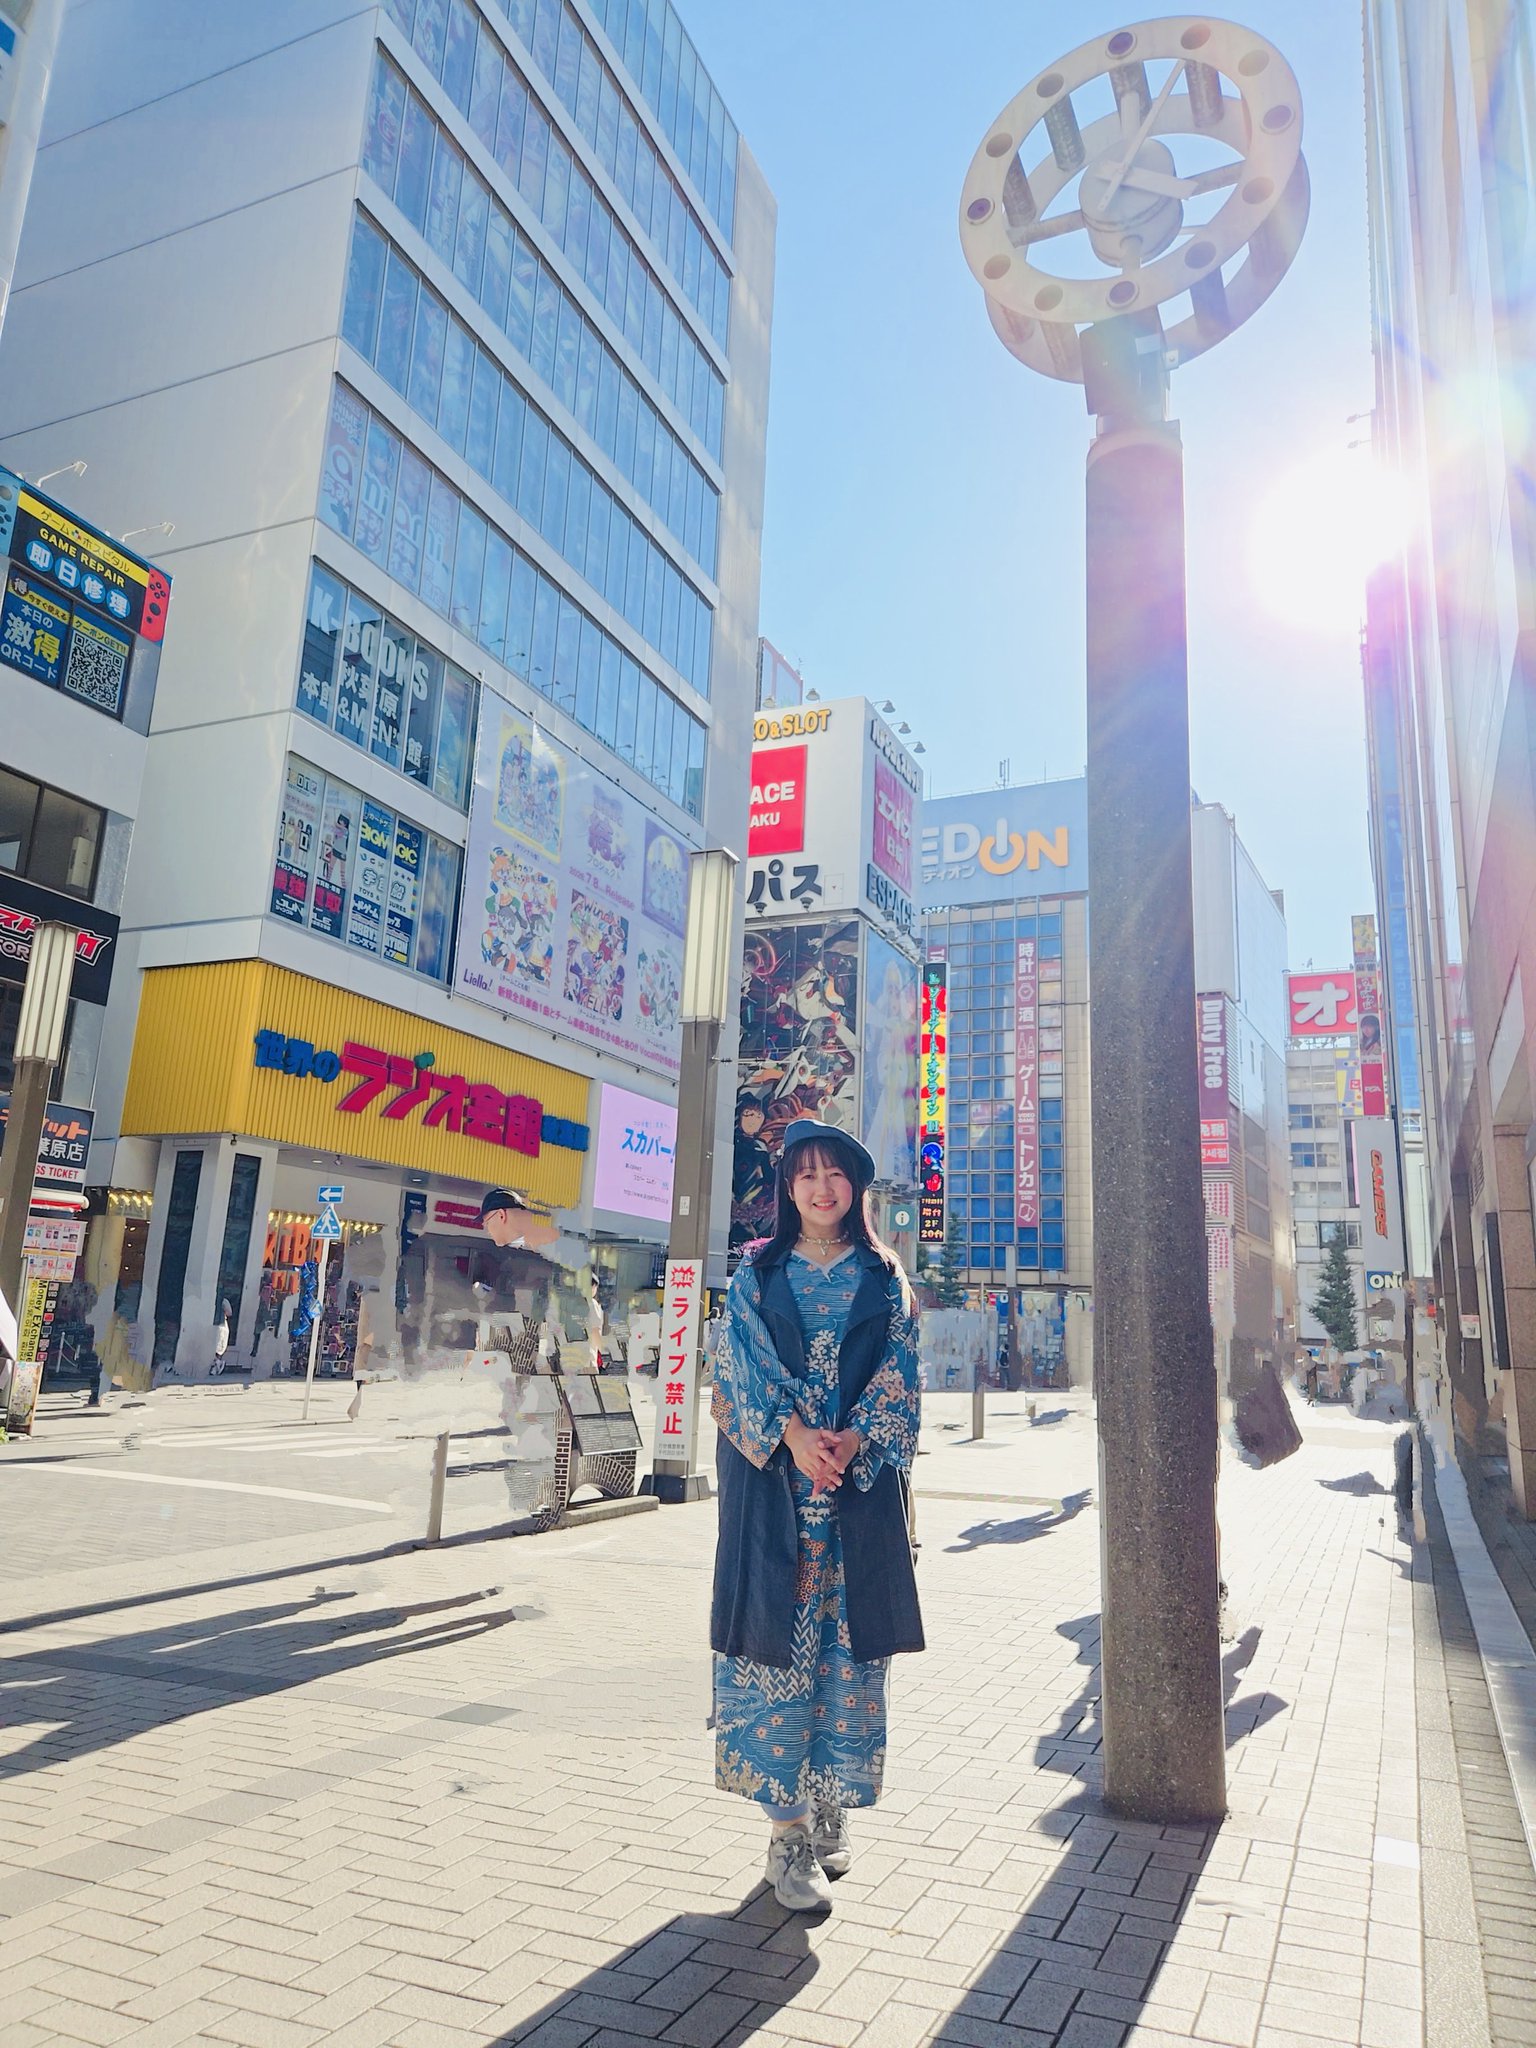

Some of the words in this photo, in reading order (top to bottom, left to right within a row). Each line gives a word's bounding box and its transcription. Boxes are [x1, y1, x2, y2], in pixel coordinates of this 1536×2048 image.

[40, 509, 71, 536] ゲーム
[39, 527, 77, 558] GAME
[80, 553, 125, 588] REPAIR
[30, 544, 130, 618] 即日修理
[21, 604, 53, 630] 本日の
[4, 612, 61, 665] 激得
[0, 643, 58, 680] QRコード
[753, 709, 831, 741] O&SLOT
[922, 818, 1069, 875] EDION
[747, 859, 823, 904] パス
[1018, 943, 1034, 974] 時計
[463, 969, 493, 991] Liella!
[1018, 1007, 1034, 1022] 酒
[1201, 1001, 1223, 1043] Duty
[254, 1028, 341, 1083] 世界の
[1203, 1046, 1224, 1089] Free
[336, 1040, 543, 1159] ラジオ会館
[1018, 1064, 1035, 1111] ゲーム
[49, 1166, 78, 1180] TICKET
[1018, 1139, 1035, 1188] トレカ
[924, 1219, 939, 1228] 2F
[35, 1280, 48, 1312] Money
[1369, 1274, 1402, 1290] ON
[662, 1296, 690, 1435] ライブ禁止
